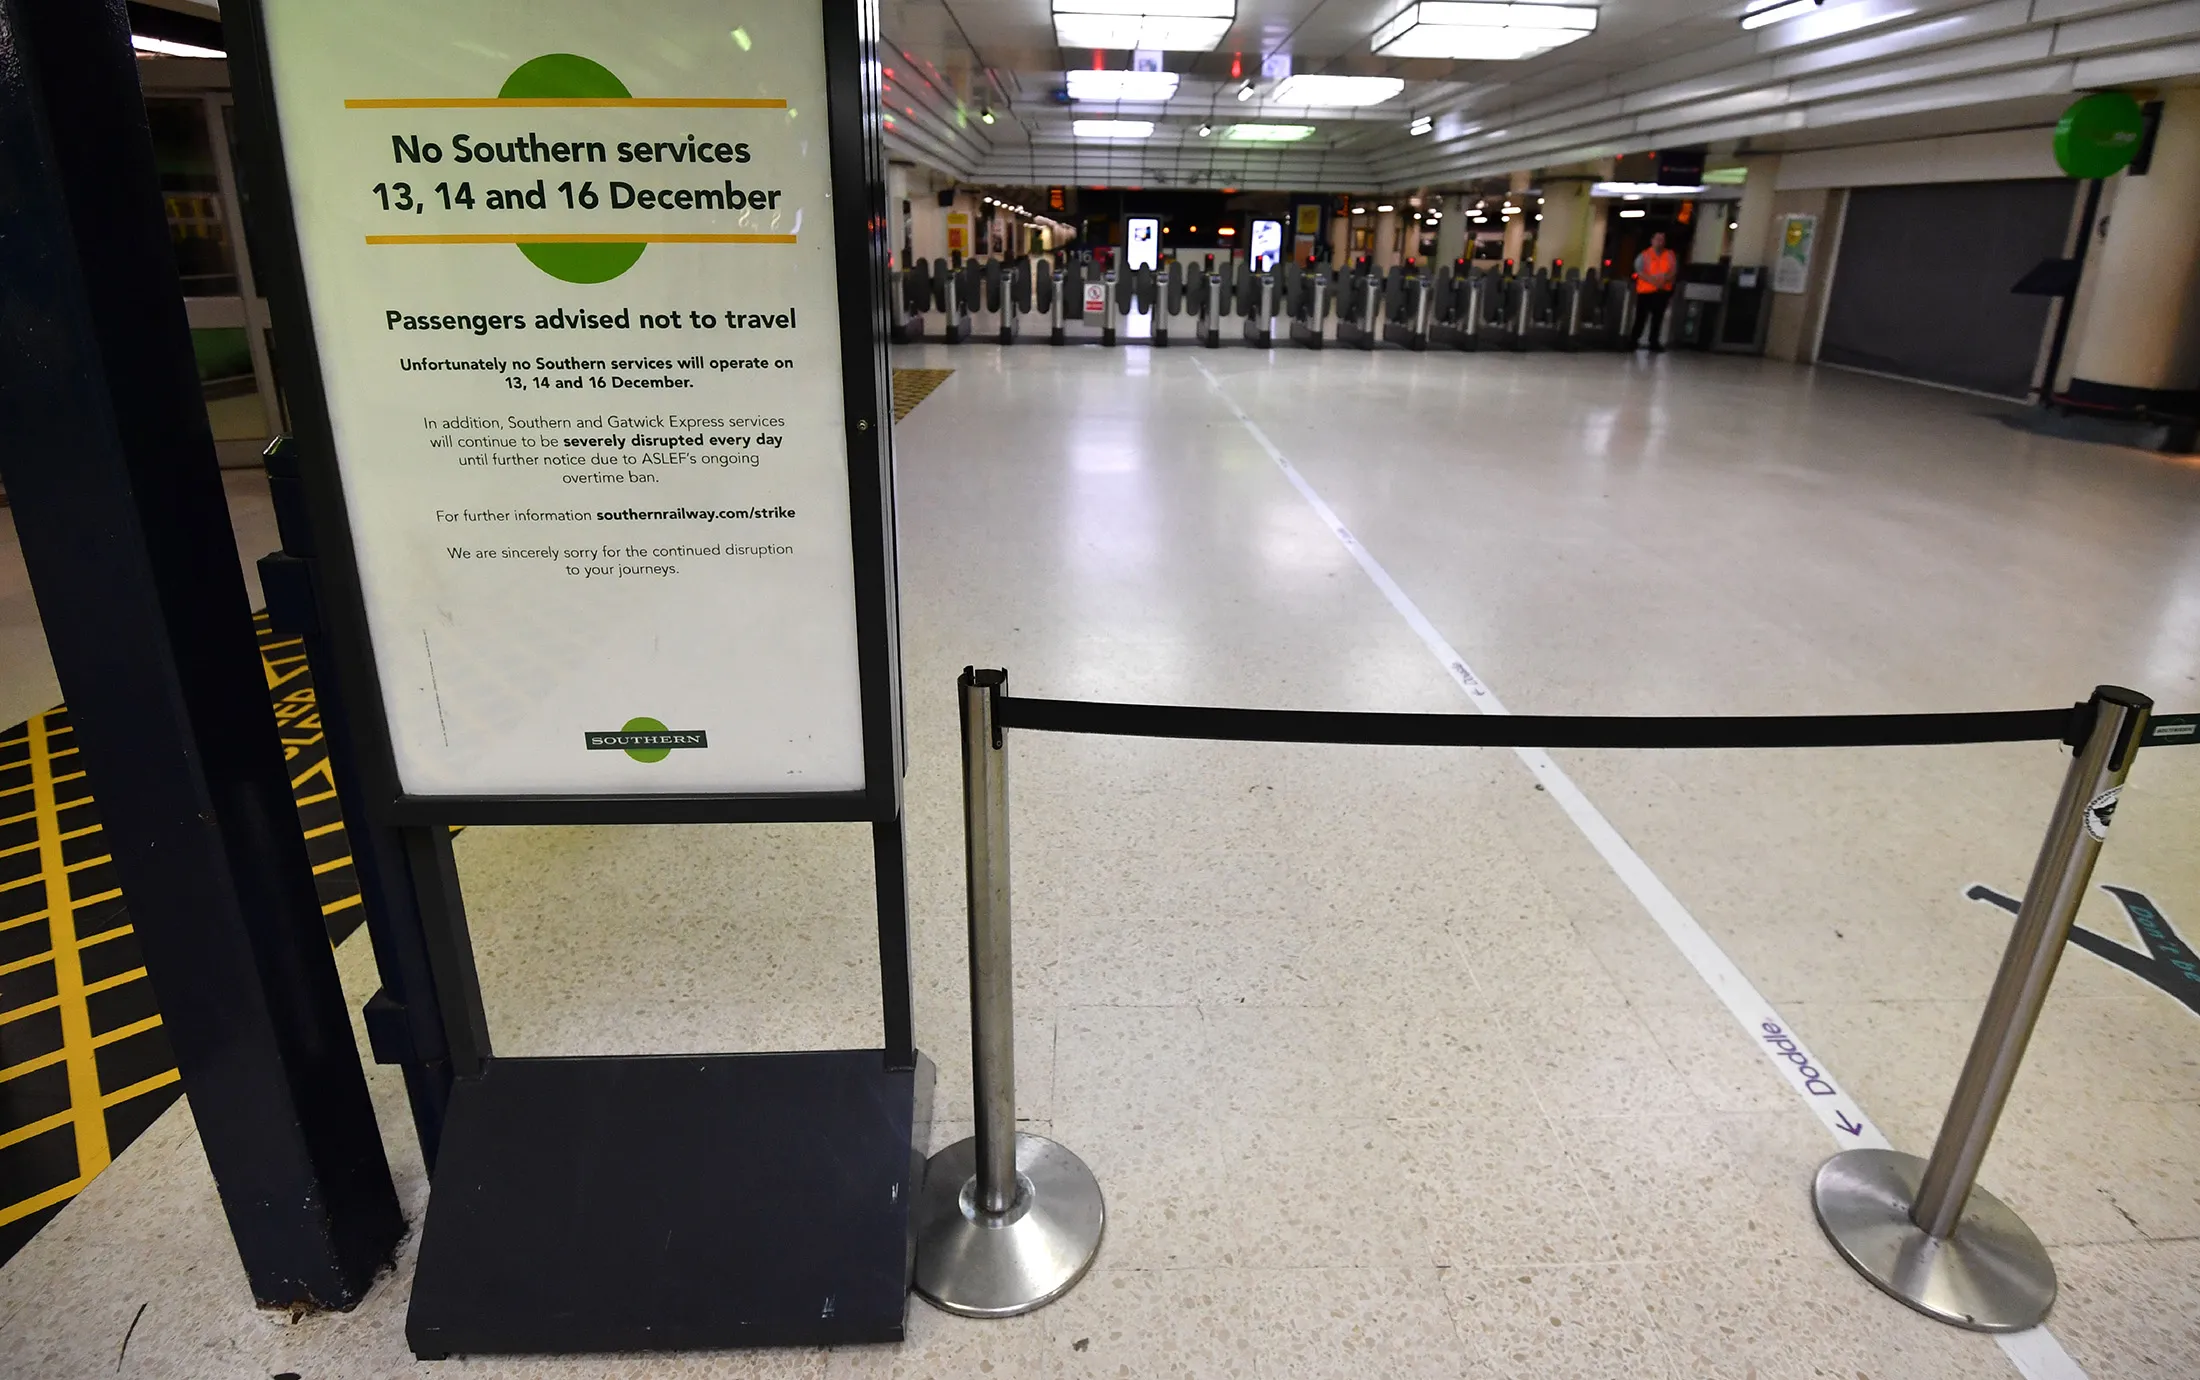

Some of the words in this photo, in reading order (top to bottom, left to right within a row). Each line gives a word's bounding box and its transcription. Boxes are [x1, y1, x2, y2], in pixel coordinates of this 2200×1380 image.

[391, 135, 443, 163] No
[452, 132, 606, 163] Southern
[617, 134, 751, 163] services
[372, 182, 423, 214] 13,
[434, 182, 476, 210] 14
[486, 179, 546, 210] and
[557, 181, 599, 210] 16
[609, 180, 781, 210] December
[386, 310, 526, 335] Passengers
[535, 307, 630, 329] advised
[639, 310, 682, 329] not
[689, 310, 717, 329] to
[724, 307, 796, 329] travel
[400, 357, 507, 374] Unfortunately
[512, 360, 531, 370] no
[536, 356, 606, 370] Southern
[611, 357, 673, 370] services
[677, 356, 704, 369] will
[709, 357, 769, 372] operate
[774, 359, 793, 369] on
[505, 376, 527, 391] 13,
[532, 376, 550, 389] 14
[555, 375, 583, 389] and
[589, 376, 607, 389] 16
[611, 375, 694, 388] December.
[424, 417, 437, 429] In
[442, 416, 504, 430] addition,
[508, 415, 571, 429] Southern
[576, 415, 603, 429] and
[607, 414, 665, 428] Gatwick
[669, 415, 725, 432] Express
[729, 415, 785, 428] services
[430, 434, 453, 448] will
[458, 435, 517, 448] continue
[521, 436, 536, 448] to
[540, 434, 559, 448] be
[563, 434, 626, 450] severely
[631, 433, 704, 449] disrupted
[709, 436, 751, 449] every
[756, 432, 783, 449] day
[459, 453, 488, 466] until
[492, 452, 539, 466] further
[543, 453, 586, 465] notice
[591, 452, 618, 465] due
[622, 454, 637, 465] to
[642, 452, 697, 465] ASLEF's
[701, 452, 759, 468] ongoing
[562, 471, 624, 484] overtime
[628, 470, 659, 483] ban.
[436, 510, 459, 522] For
[463, 509, 510, 522] further
[514, 508, 592, 521] information
[596, 506, 796, 523] southernrailway.com/strike
[446, 547, 471, 559] We
[476, 550, 497, 559] are
[501, 546, 559, 562] sincerely
[563, 549, 598, 561] sorry
[602, 545, 621, 558] for
[625, 545, 648, 558] the
[652, 543, 721, 557] continued
[725, 543, 793, 559] disruption
[565, 565, 580, 575] to
[584, 566, 614, 579] your
[618, 563, 679, 578] journeys.
[591, 735, 701, 745] SOUTHERN
[1761, 1021, 1837, 1096] Doddle
